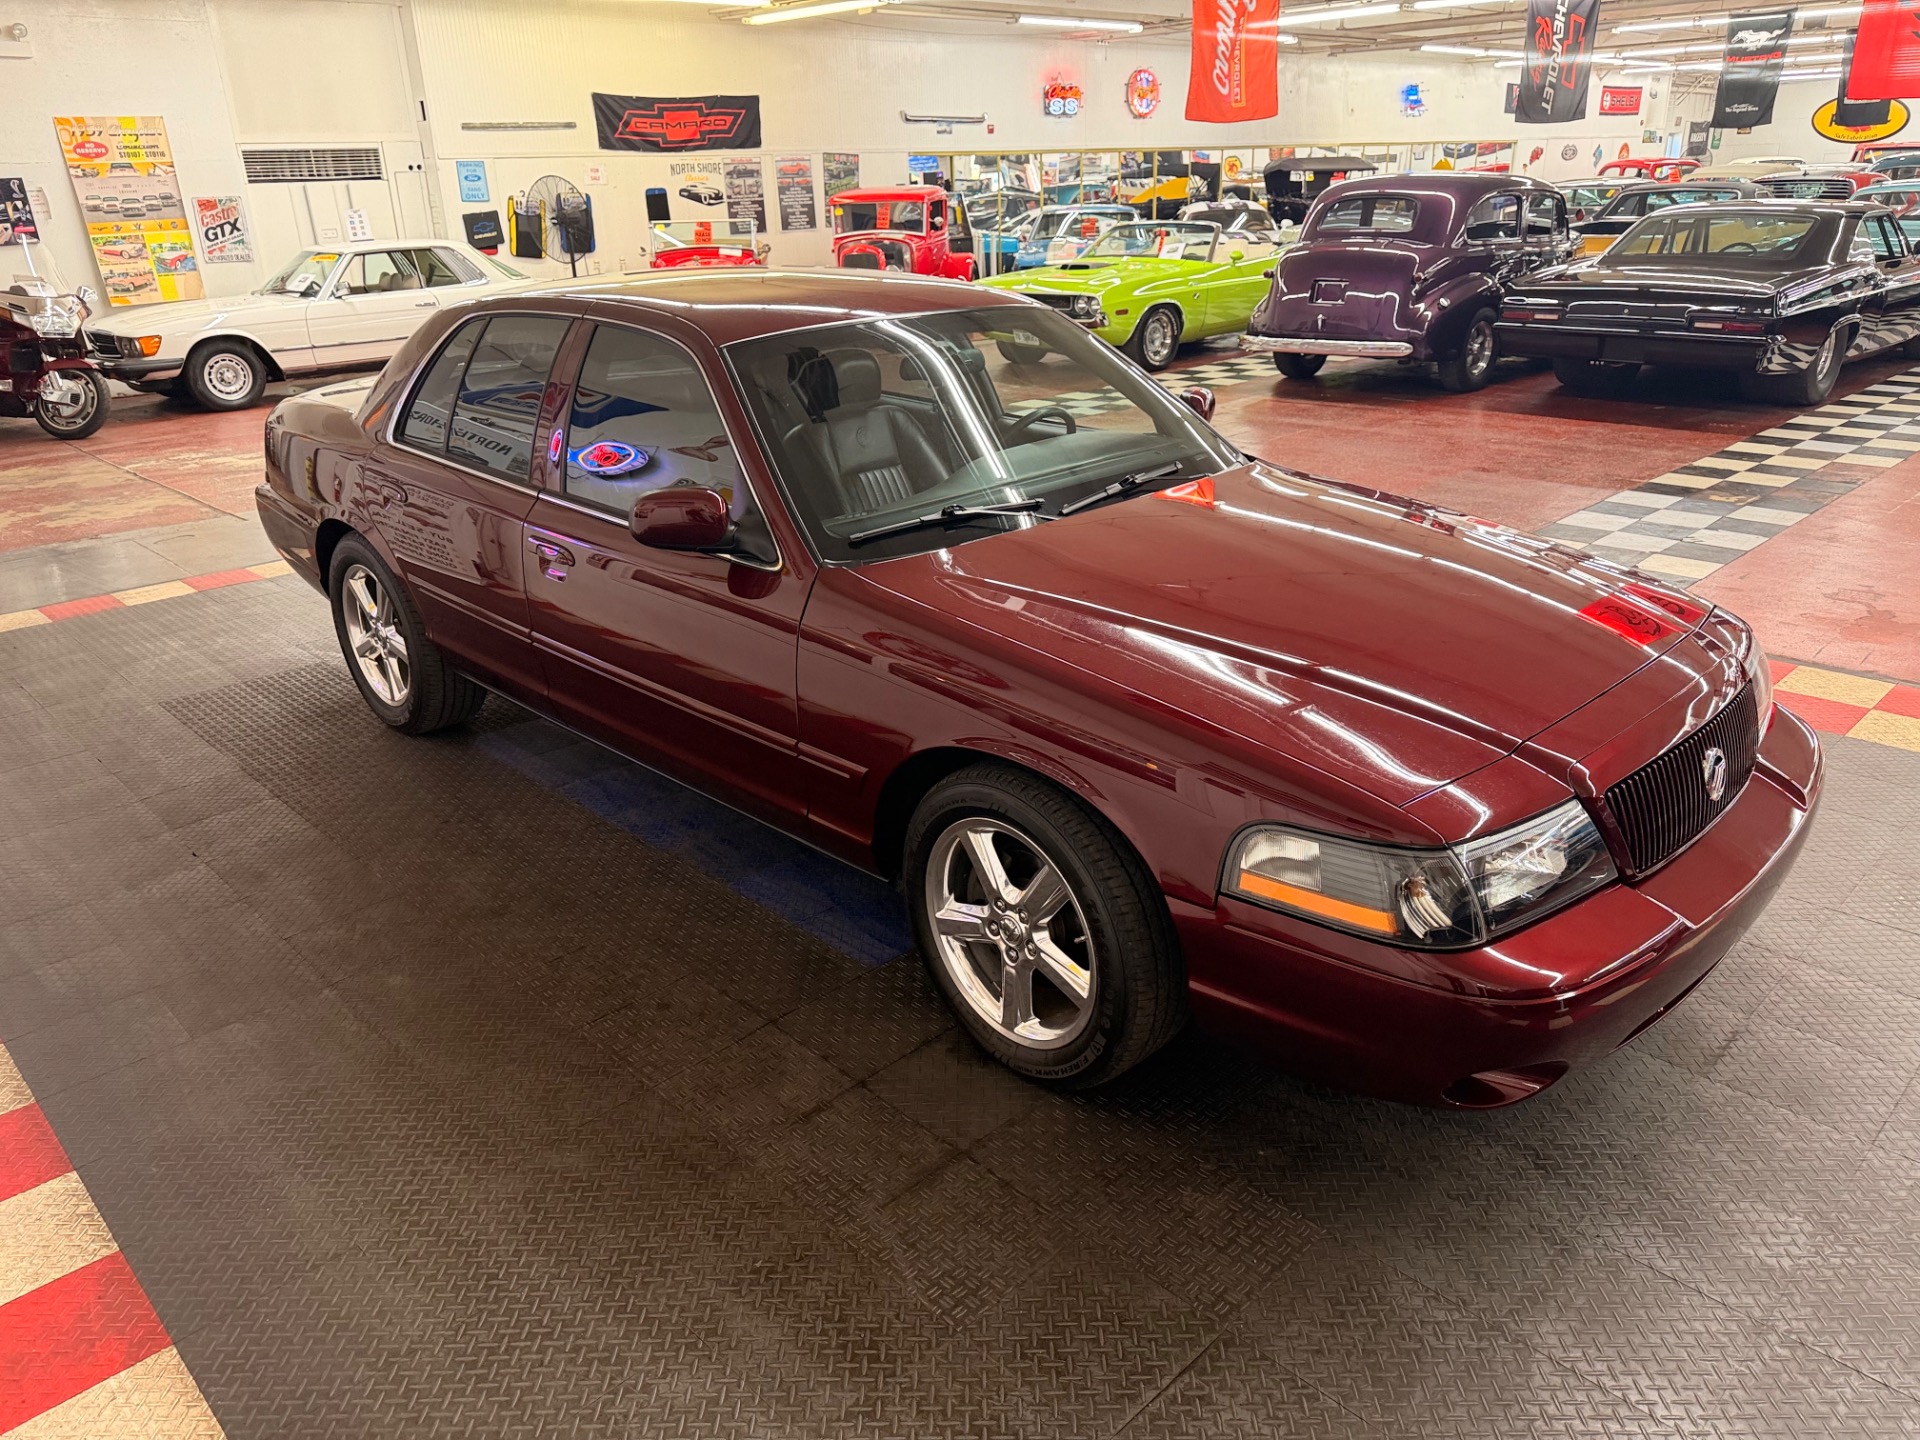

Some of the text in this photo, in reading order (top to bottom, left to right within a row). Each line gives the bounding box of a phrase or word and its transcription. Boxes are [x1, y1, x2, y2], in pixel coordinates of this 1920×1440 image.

[1726, 51, 1782, 63] MUSTANG
[1049, 98, 1078, 114] SS
[1610, 96, 1639, 106] SHELBY
[634, 118, 727, 130] CAMARO
[670, 163, 722, 176] NORTH SHORE
[204, 217, 242, 242] GTX
[1034, 1055, 1089, 1076] FIREHAWK
